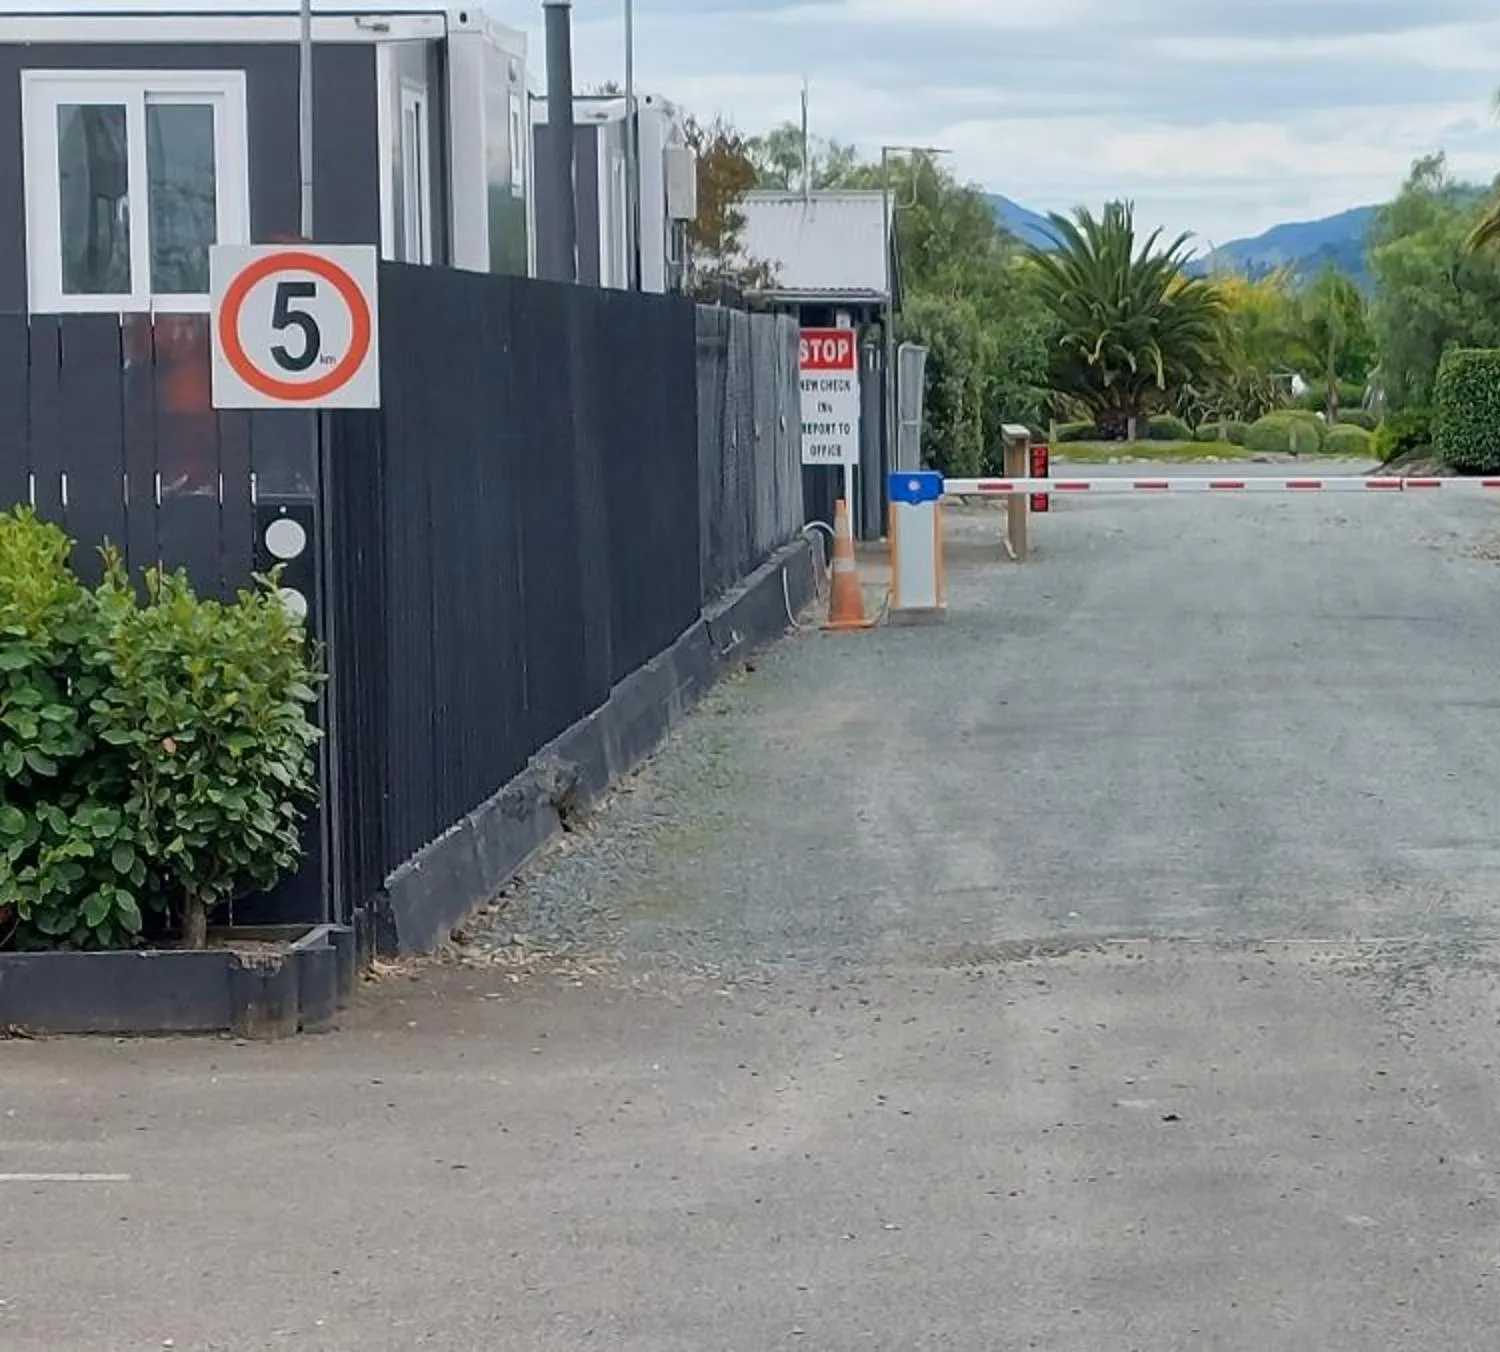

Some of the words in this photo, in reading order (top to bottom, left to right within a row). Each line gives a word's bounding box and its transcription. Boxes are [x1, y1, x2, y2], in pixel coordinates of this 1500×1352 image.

[270, 282, 321, 372] 5
[320, 354, 336, 365] km
[799, 338, 849, 363] STOP
[820, 379, 850, 392] CHECK
[839, 423, 850, 435] TO
[809, 444, 841, 457] OFFICE
